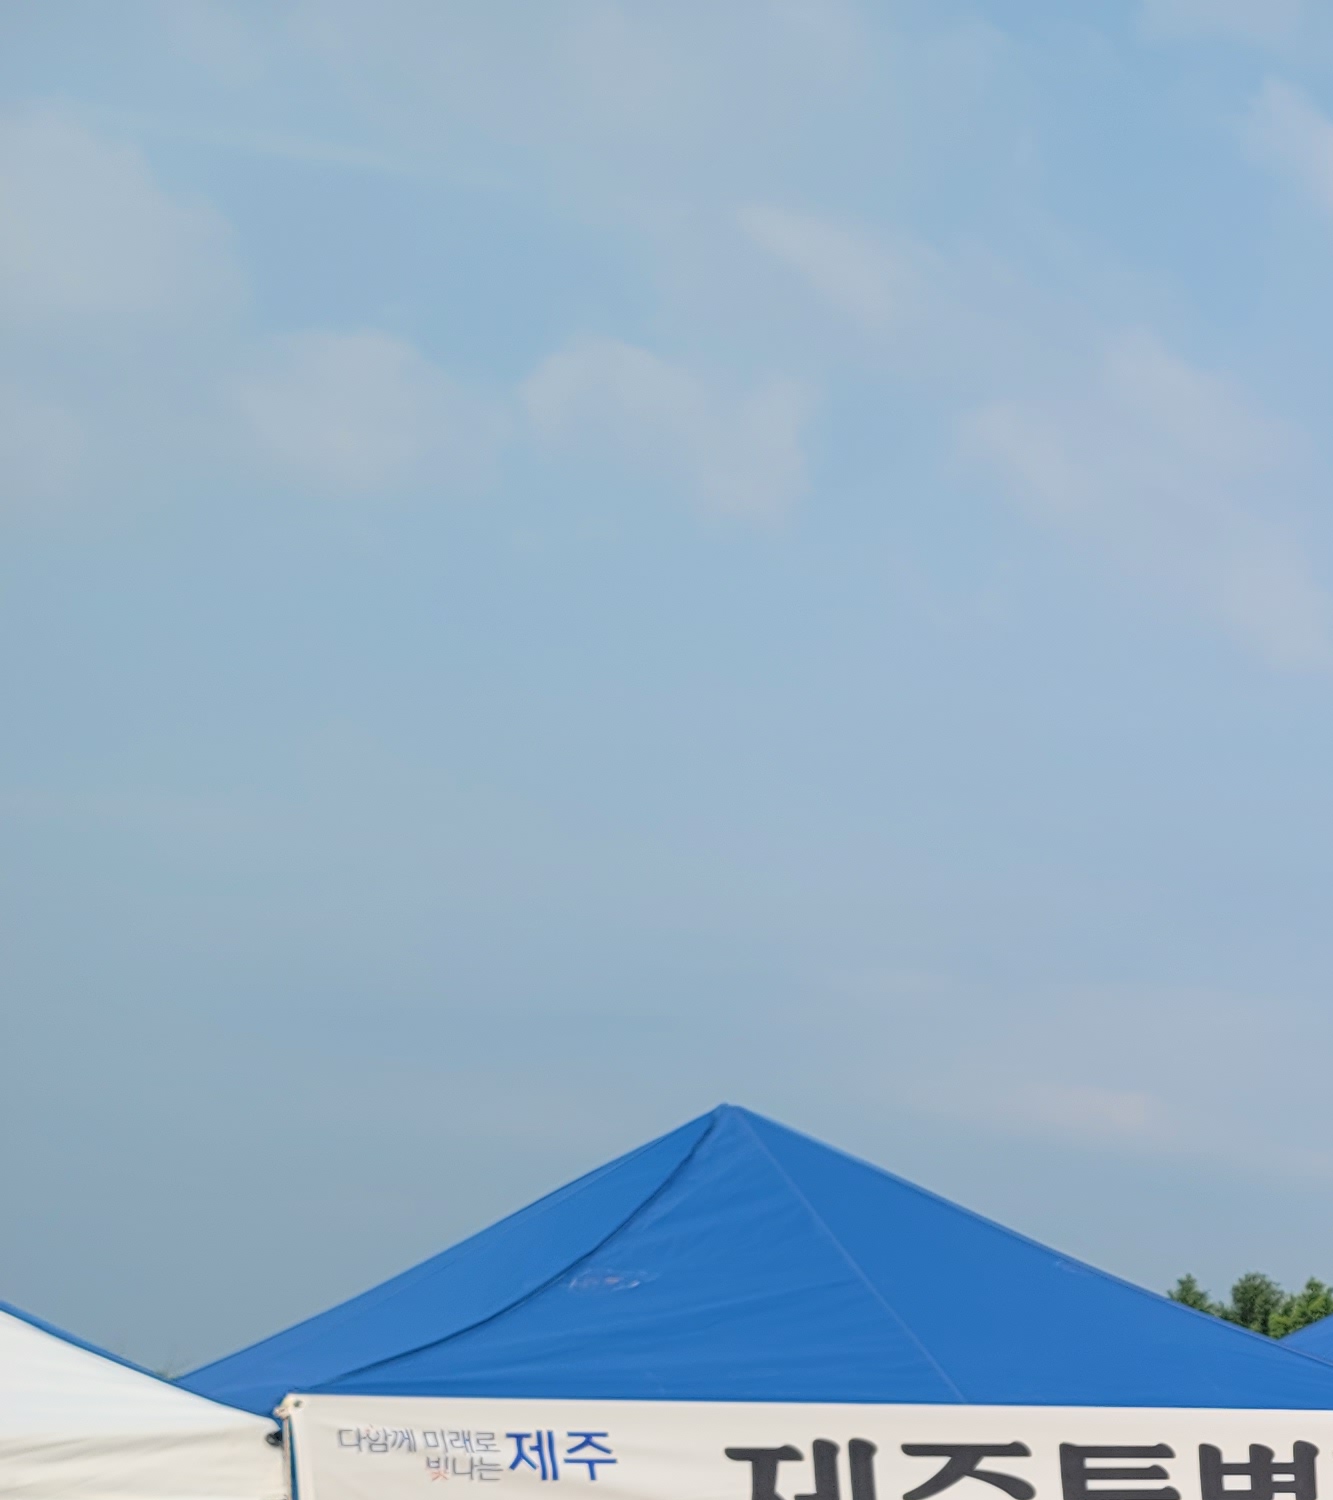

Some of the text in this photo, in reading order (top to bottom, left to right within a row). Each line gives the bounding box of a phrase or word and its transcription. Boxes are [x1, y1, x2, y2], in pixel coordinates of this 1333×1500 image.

[423, 1428, 501, 1453] 미래로
[426, 1429, 618, 1481] 빛나는 제주
